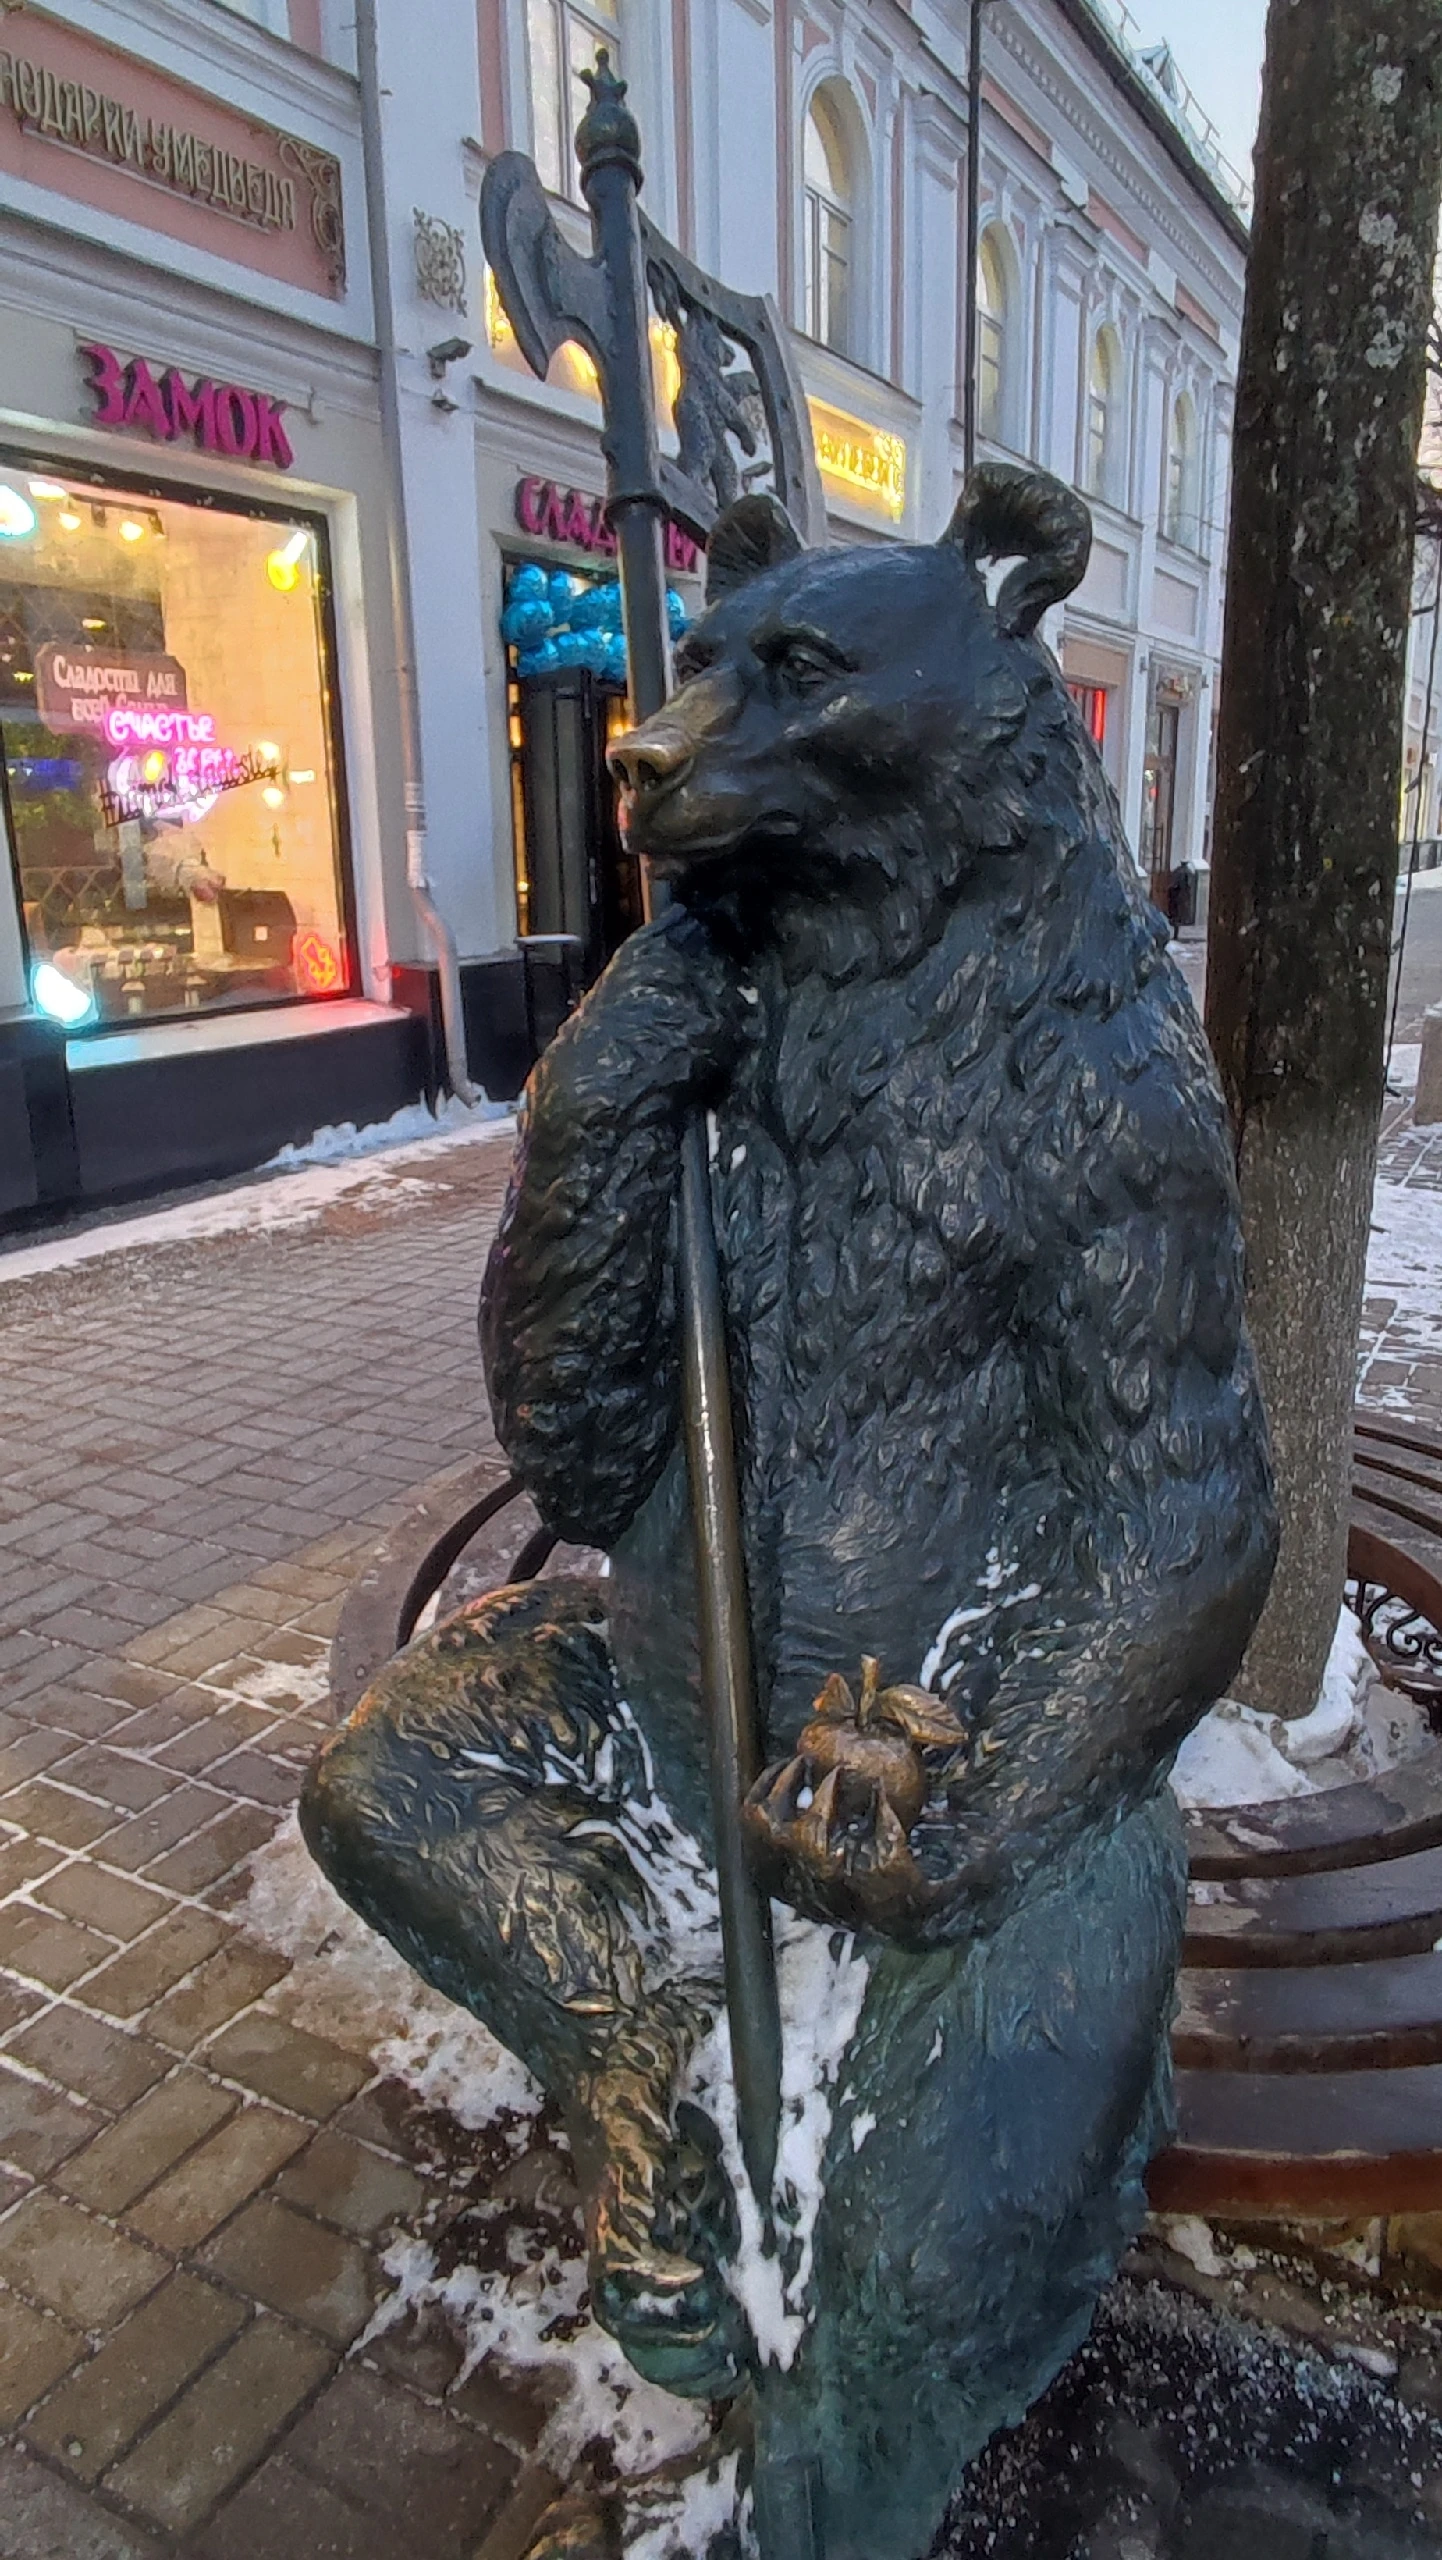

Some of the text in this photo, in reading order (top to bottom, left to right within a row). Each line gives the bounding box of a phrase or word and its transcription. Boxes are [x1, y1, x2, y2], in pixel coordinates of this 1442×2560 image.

[0, 47, 145, 168] ПОДАРКИ
[77, 343, 294, 469] ЗАМОК
[53, 655, 142, 694] Сладости
